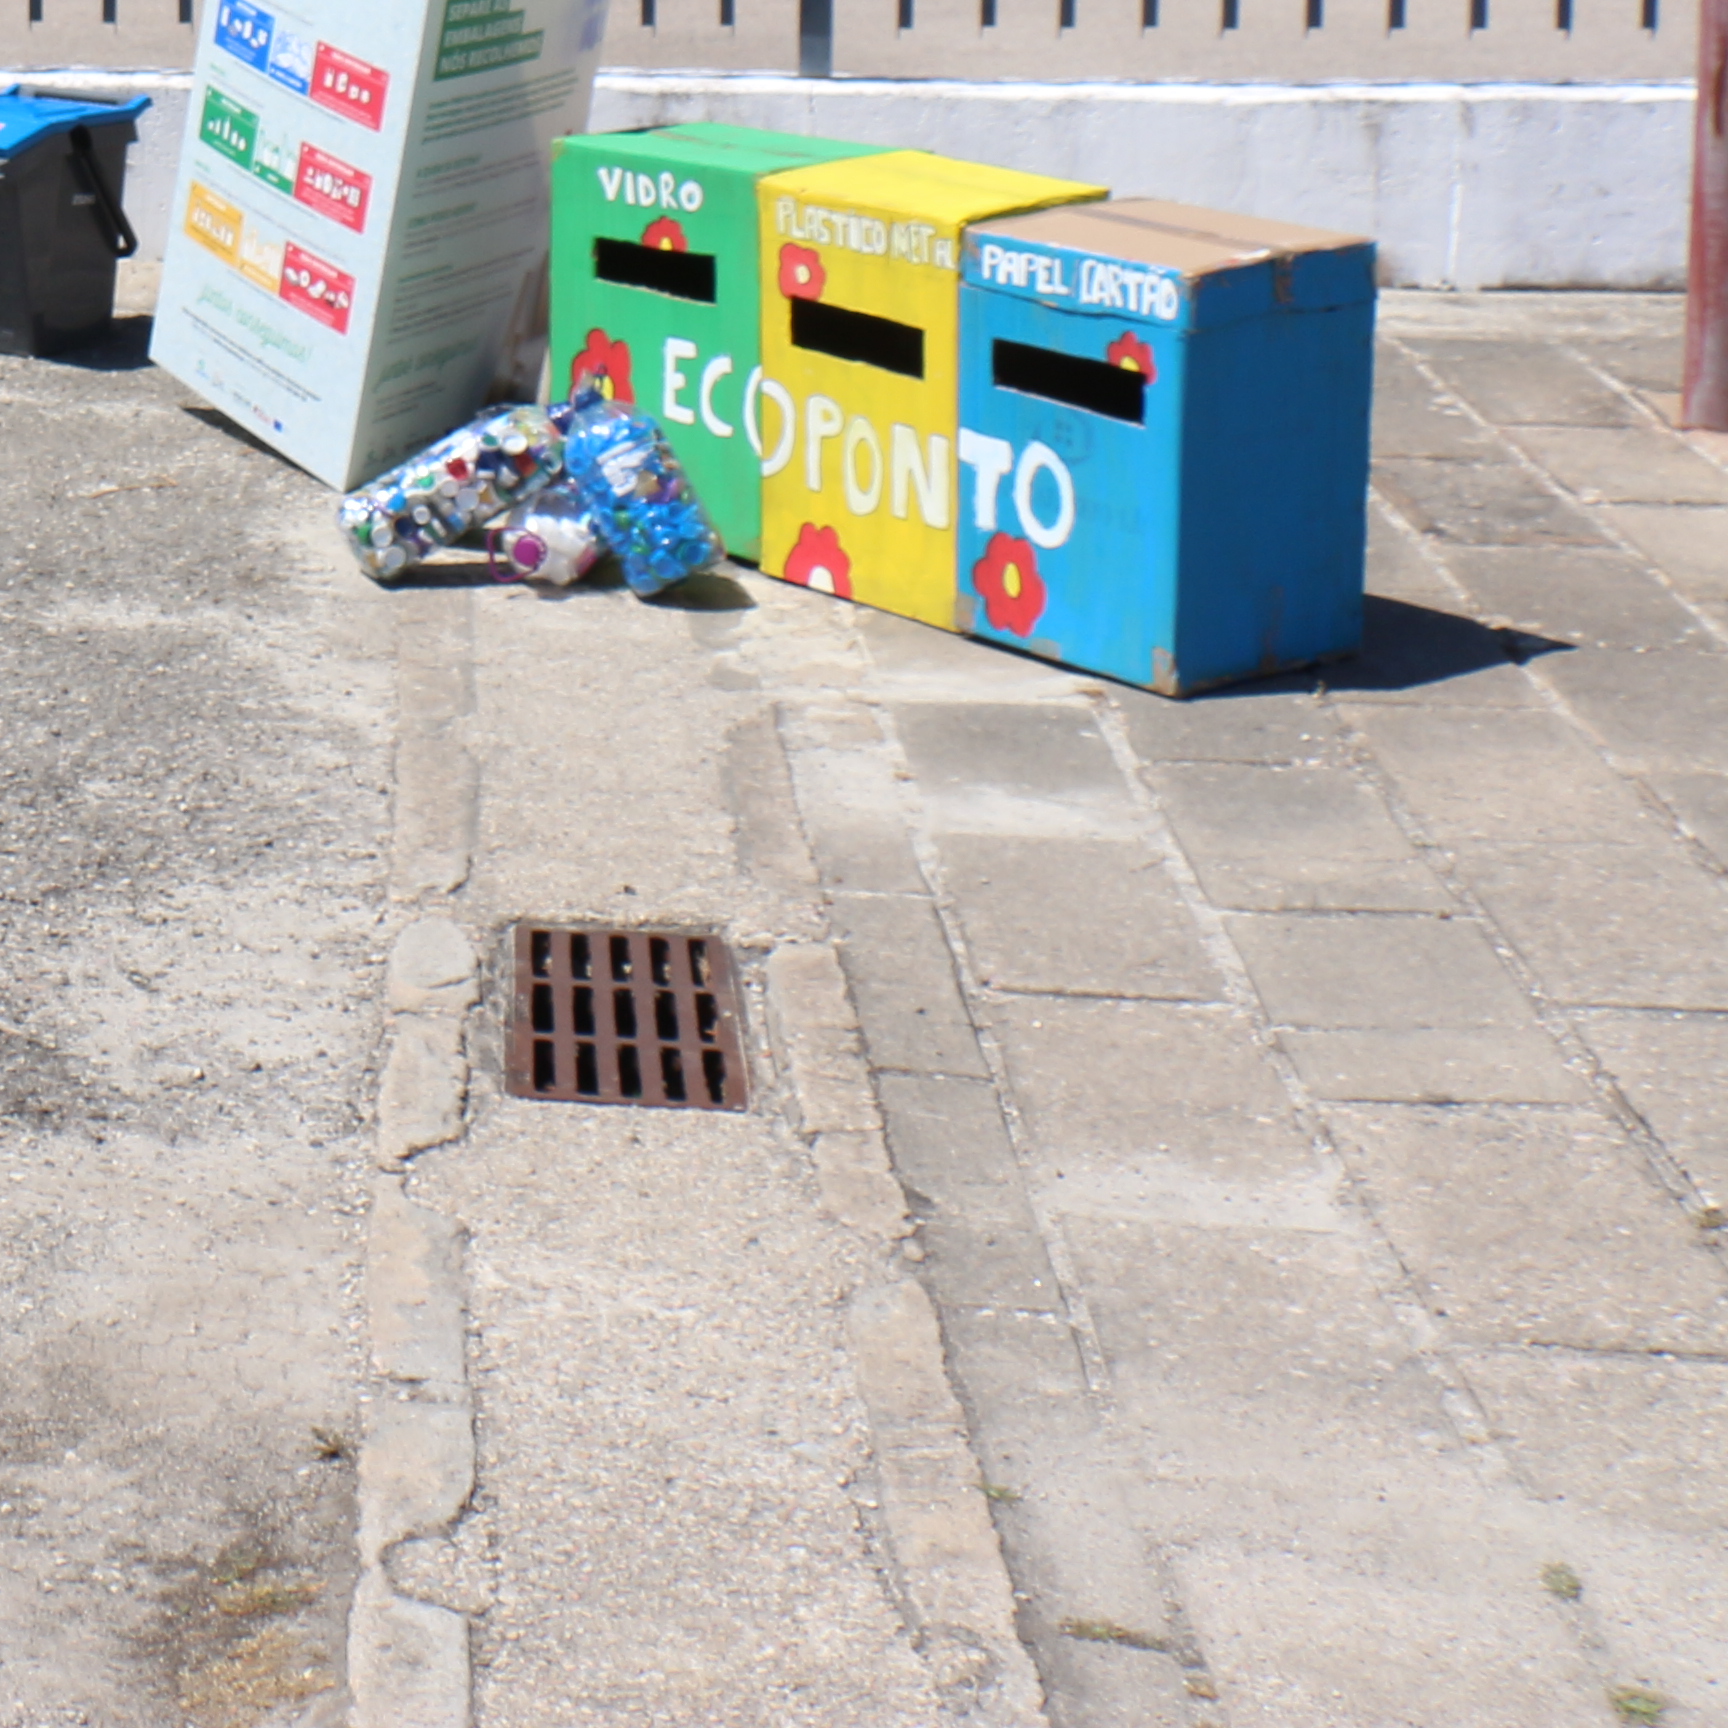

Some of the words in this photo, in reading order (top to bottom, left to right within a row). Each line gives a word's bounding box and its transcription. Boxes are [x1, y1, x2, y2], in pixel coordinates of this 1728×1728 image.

[597, 166, 703, 212] VIDRO
[981, 243, 1069, 295] PAPEL
[1078, 258, 1179, 320] CARTÃO
[662, 336, 1075, 548] ECOPONTO
